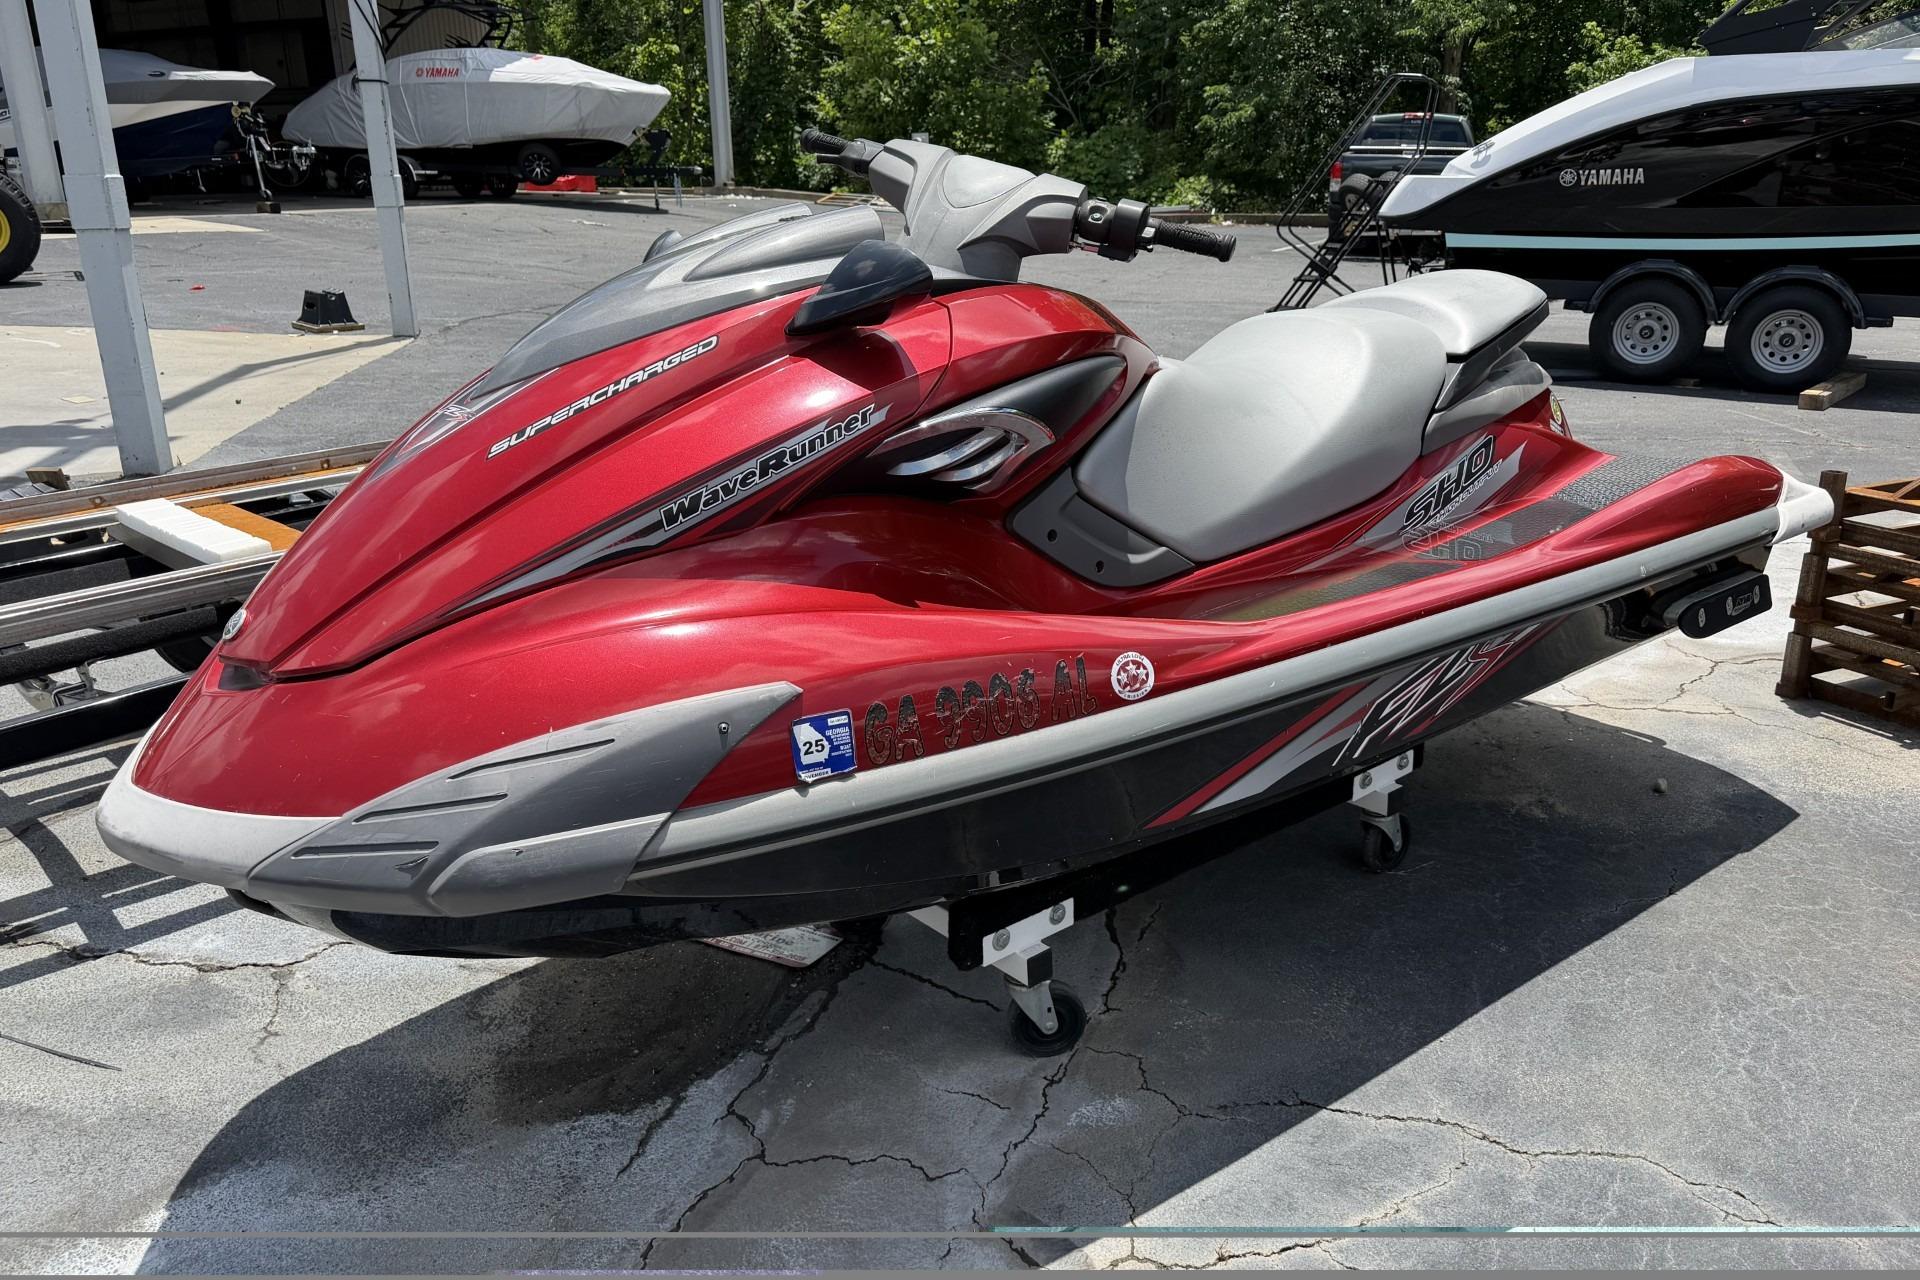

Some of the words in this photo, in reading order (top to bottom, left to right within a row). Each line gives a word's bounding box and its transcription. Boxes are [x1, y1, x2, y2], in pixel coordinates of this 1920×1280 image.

[425, 68, 459, 78] YAMAHA
[1579, 168, 1645, 186] YAMAHA
[487, 335, 719, 459] SUPERCHARGED
[659, 404, 875, 532] WaveRunner
[1403, 434, 1495, 527] SHO
[826, 727, 849, 736] GEORGIA
[864, 694, 925, 765] GA
[1051, 655, 1097, 721] AL
[803, 739, 825, 755] 25
